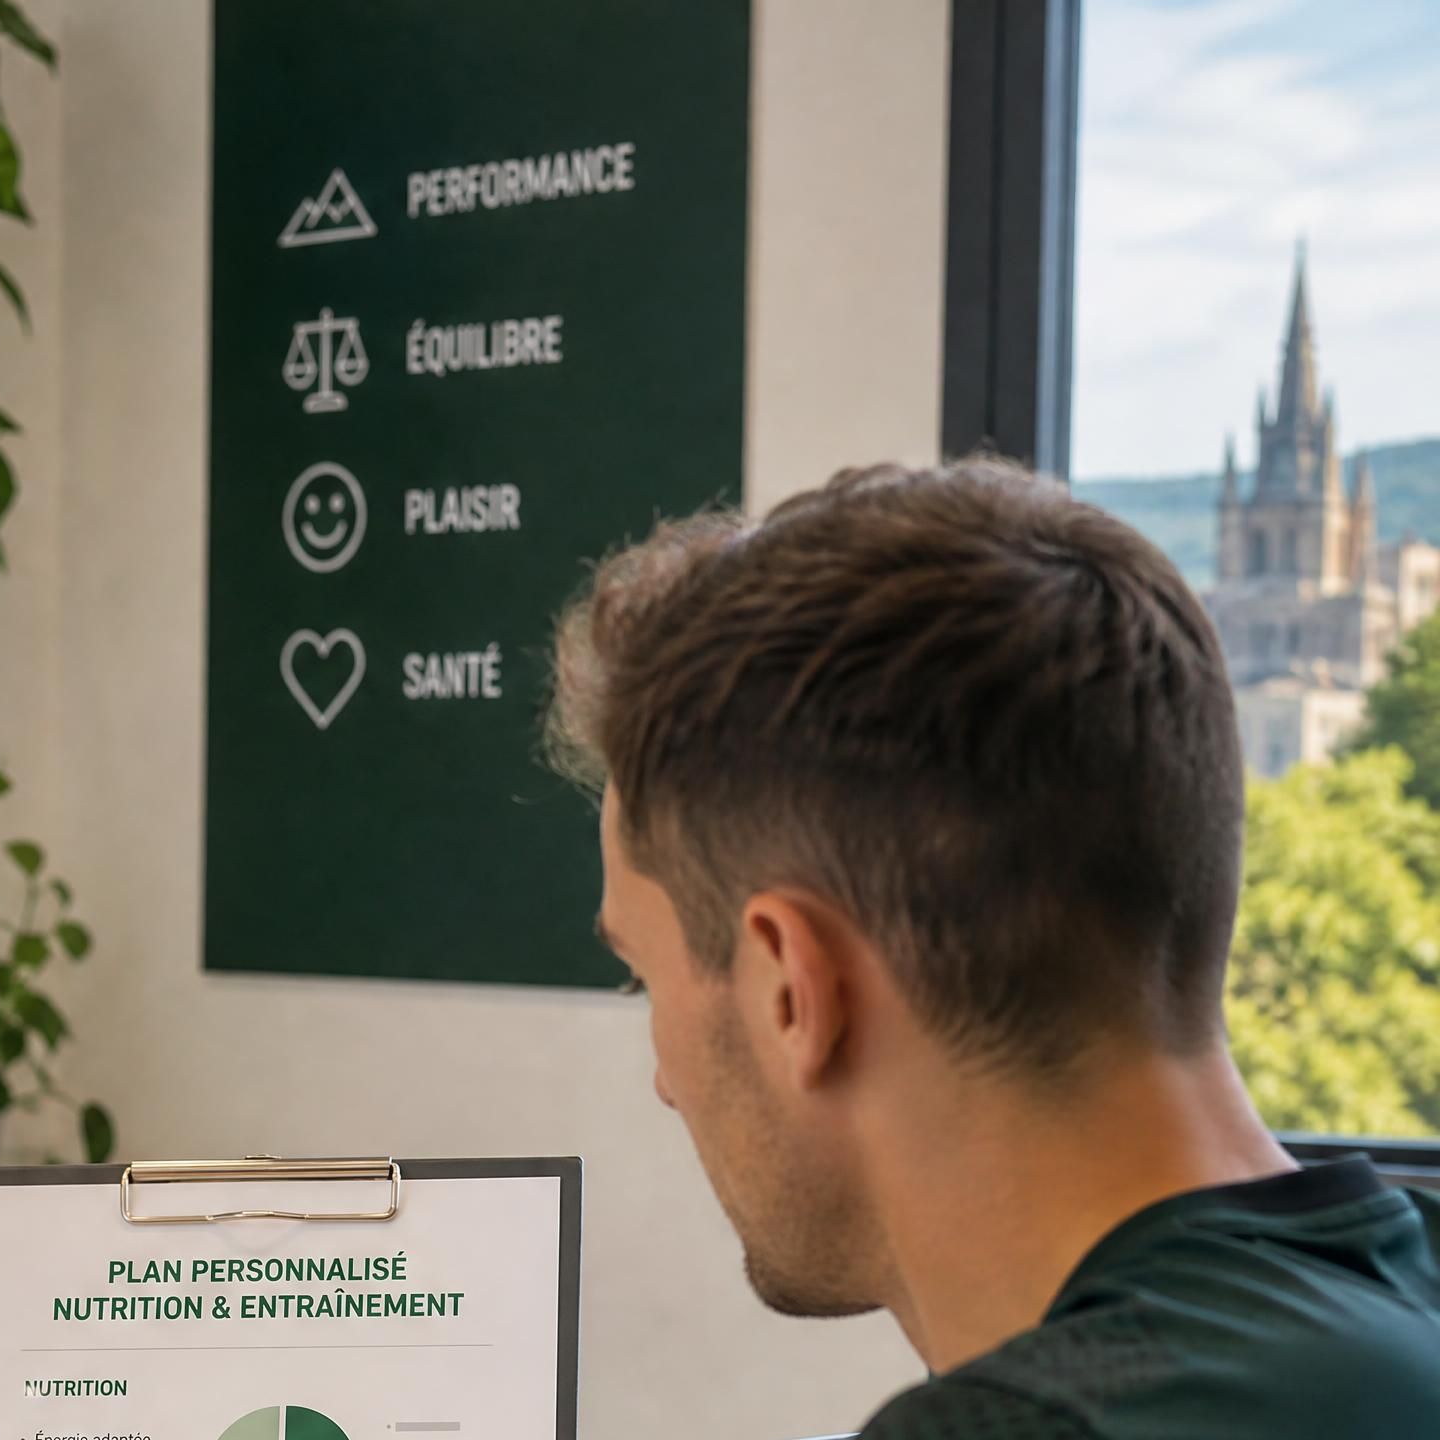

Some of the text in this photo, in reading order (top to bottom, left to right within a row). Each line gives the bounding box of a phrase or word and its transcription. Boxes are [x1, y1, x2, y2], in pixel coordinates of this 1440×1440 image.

[407, 142, 635, 218] PERFORMANCE
[406, 315, 564, 376] ÉQUILIBRE
[405, 483, 521, 535] PLAISIR
[402, 642, 502, 700] SANTÉ
[108, 1250, 408, 1284] PLAN PERSONNALISÉ
[53, 1287, 465, 1321] NUTRITION & ENTRAÎNEMENT
